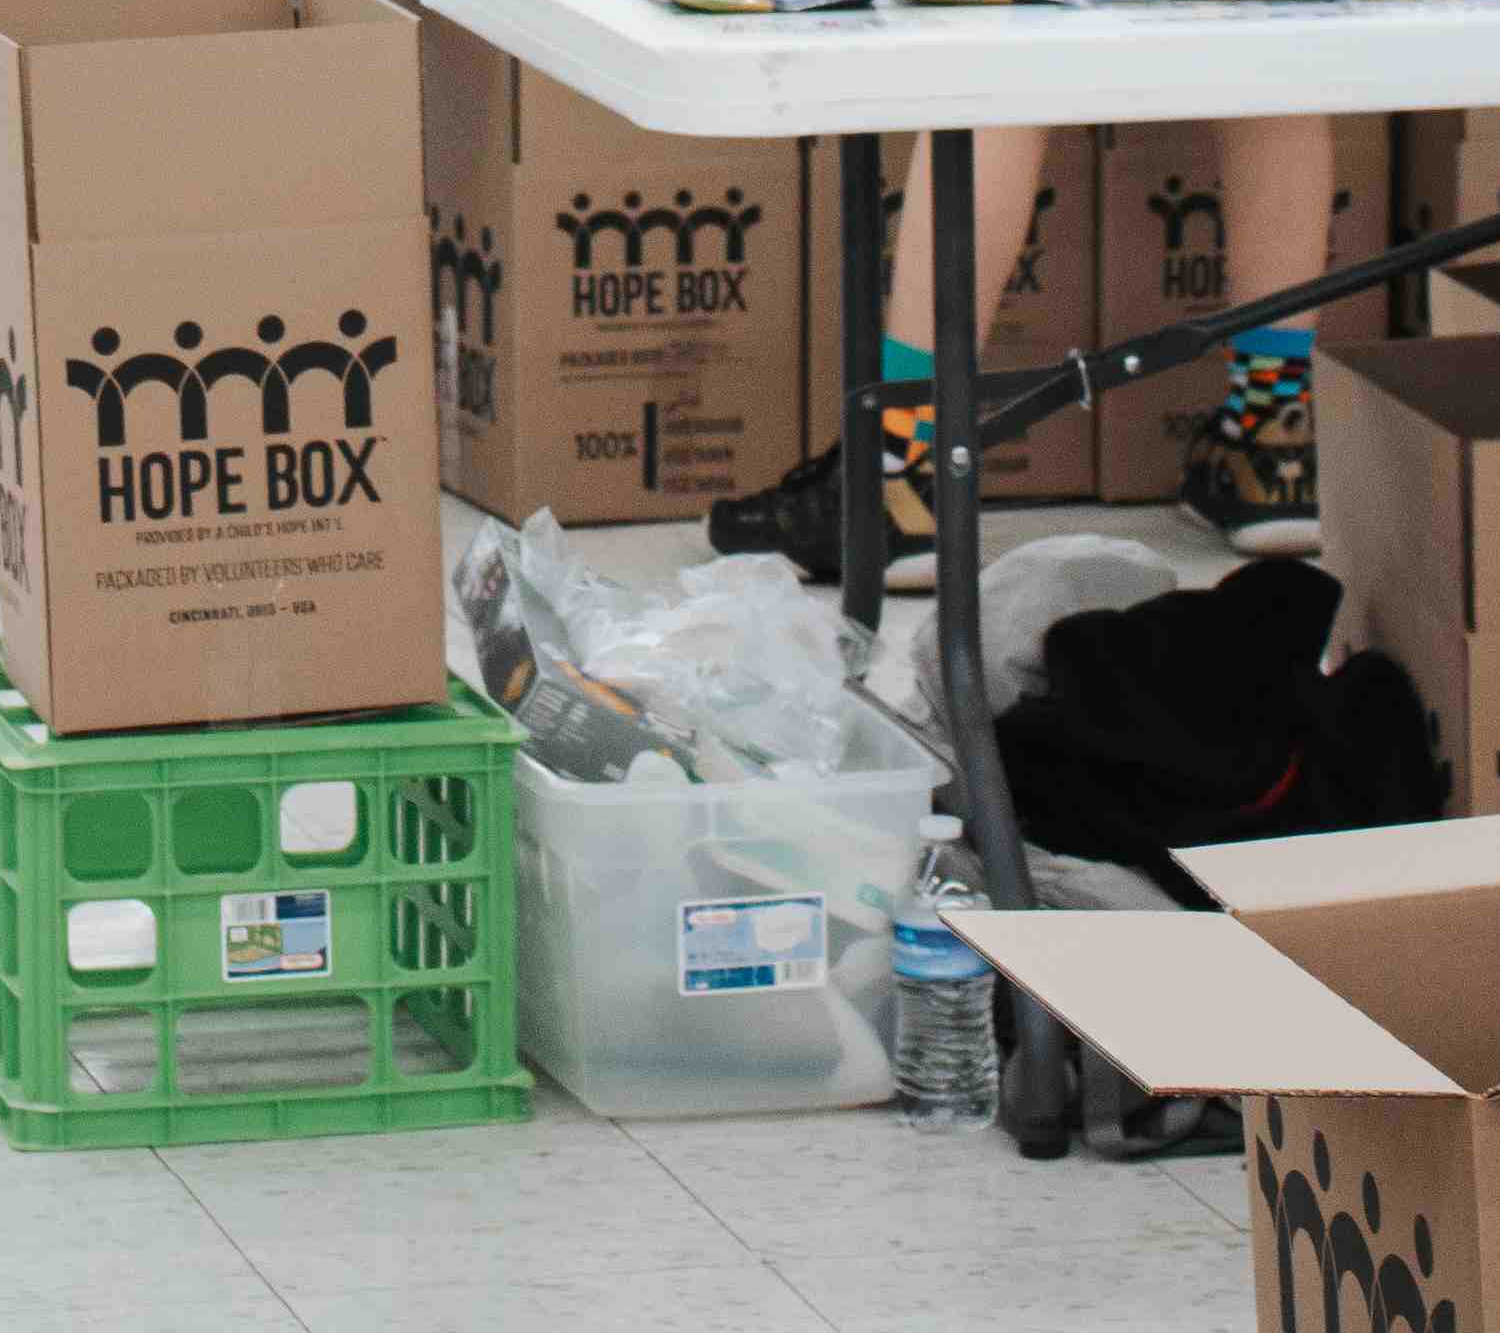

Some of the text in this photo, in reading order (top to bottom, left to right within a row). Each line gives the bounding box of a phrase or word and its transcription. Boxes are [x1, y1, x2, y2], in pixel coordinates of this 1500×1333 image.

[572, 267, 748, 318] HOPE BOX
[97, 437, 383, 525] HOPE BOX
[135, 531, 191, 546] PROVIDED
[276, 520, 309, 536] HOPE
[95, 550, 386, 591] PACKAGED BY VOLUNTEERS WHO CARE
[291, 600, 317, 616] USA
